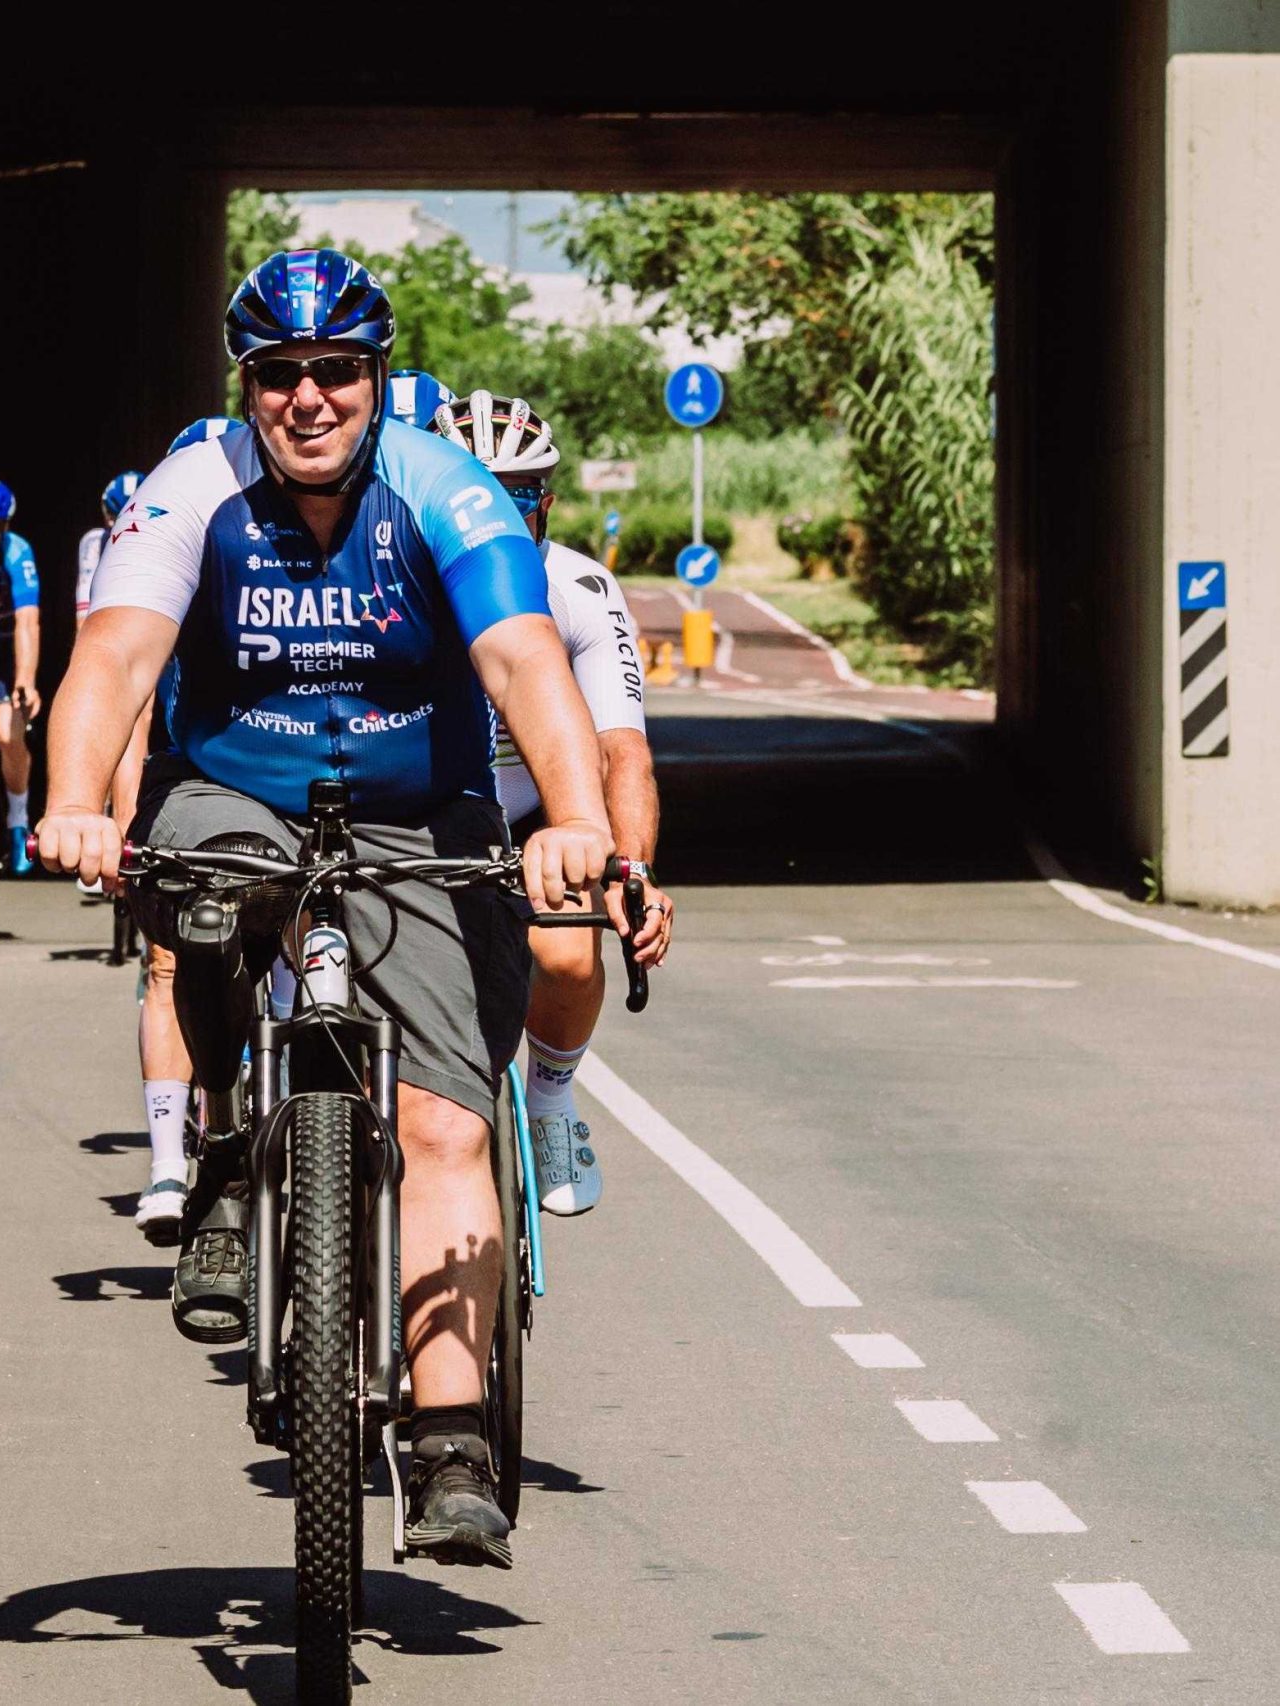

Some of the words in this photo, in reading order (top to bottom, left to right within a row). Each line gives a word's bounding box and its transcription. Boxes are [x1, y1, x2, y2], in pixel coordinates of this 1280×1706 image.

[262, 560, 291, 568] BLACK
[237, 586, 361, 627] ISRAEL
[289, 641, 376, 659] PREMIER
[608, 610, 643, 703] FACTOR
[290, 658, 343, 673] TECH
[287, 681, 364, 695] ACADEMY
[231, 705, 316, 735] FANTINI
[251, 708, 291, 721] CANTINA
